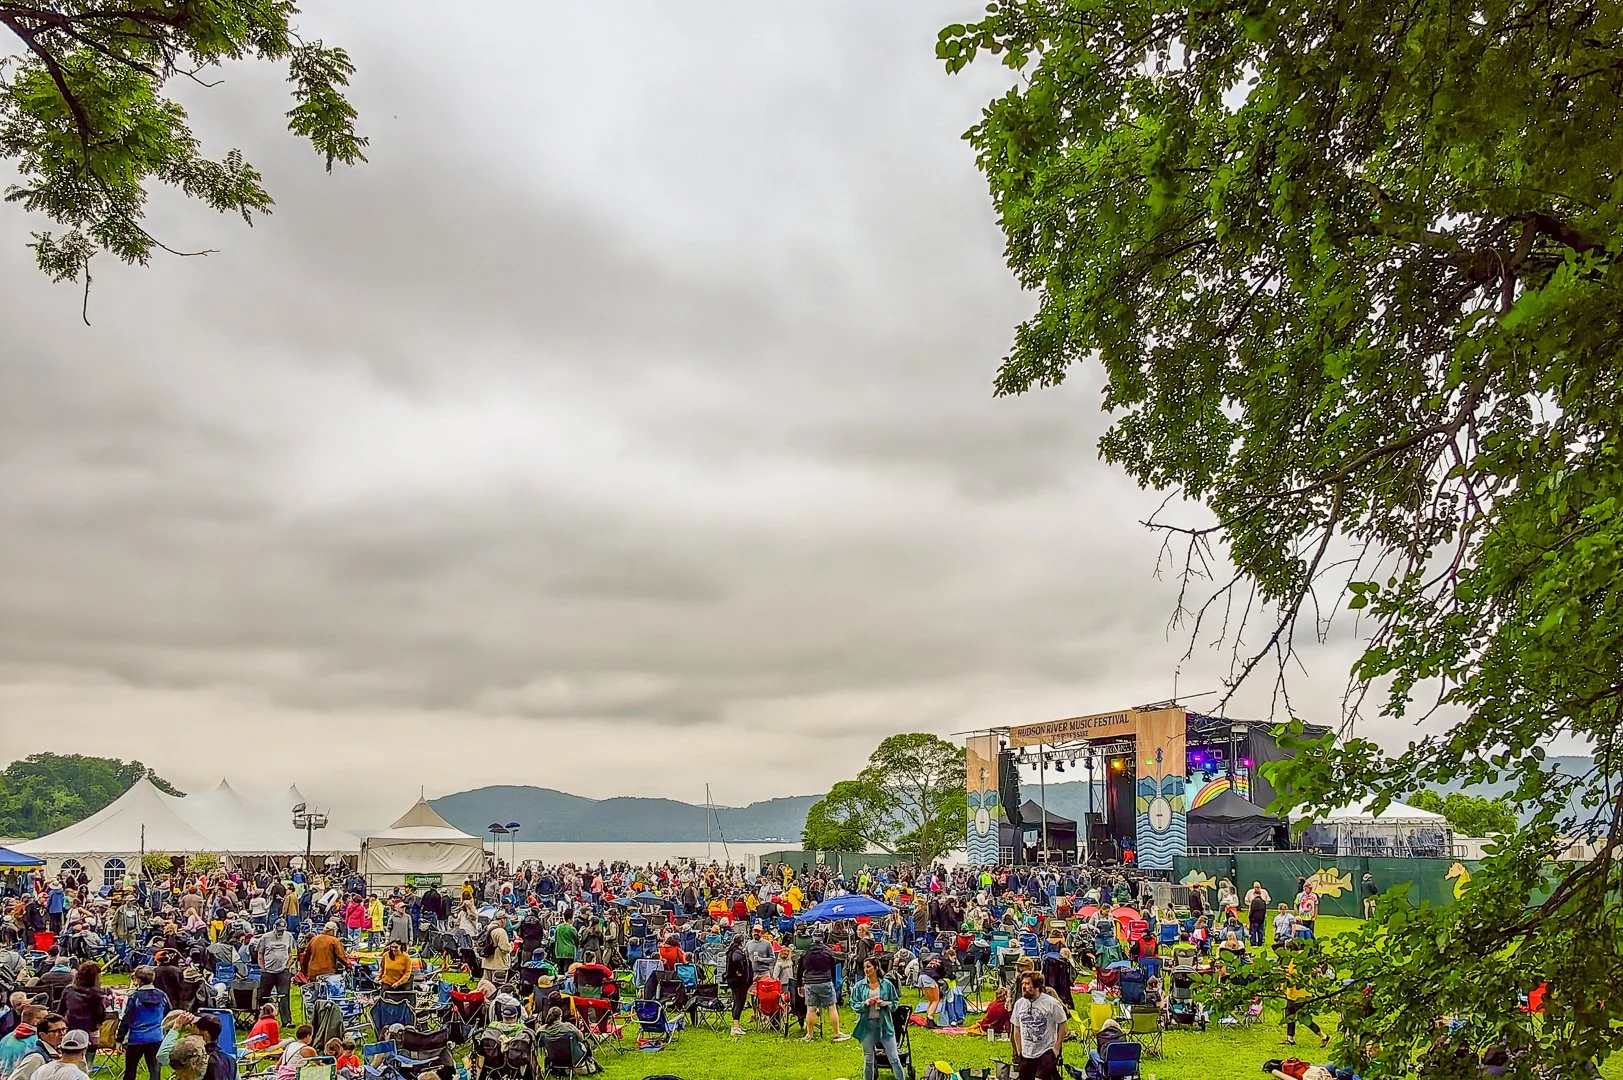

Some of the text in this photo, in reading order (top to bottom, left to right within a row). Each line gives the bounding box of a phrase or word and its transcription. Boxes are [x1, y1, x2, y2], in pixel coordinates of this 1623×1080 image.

[1017, 714, 1129, 738] HUDSON RIVER MUSIC FESTIVAL
